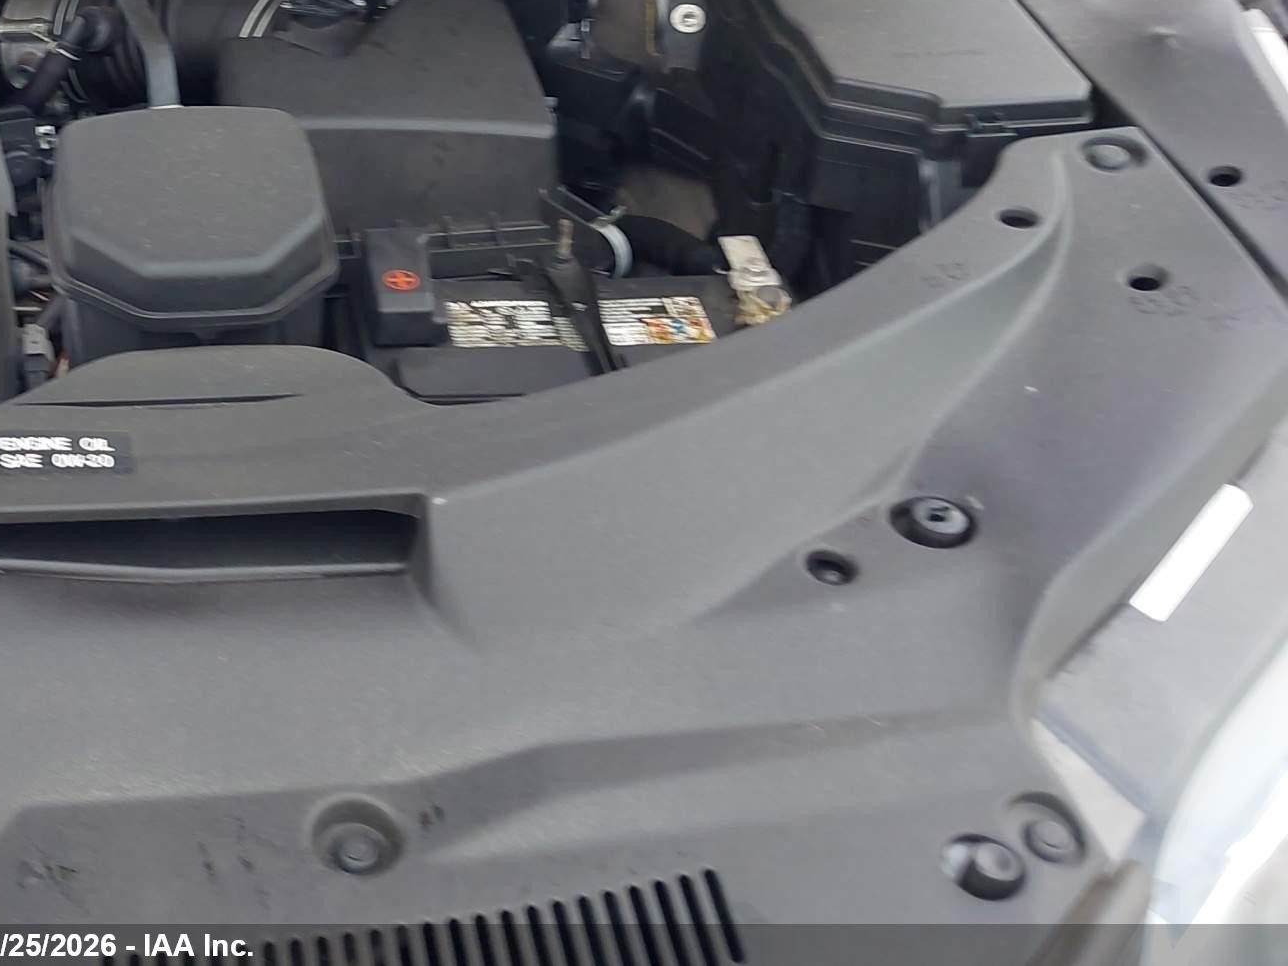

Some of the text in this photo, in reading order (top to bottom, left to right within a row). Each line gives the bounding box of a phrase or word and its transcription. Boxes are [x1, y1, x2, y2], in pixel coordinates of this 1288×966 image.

[0, 437, 116, 452] ENGINE OIL
[0, 453, 44, 469] SAE
